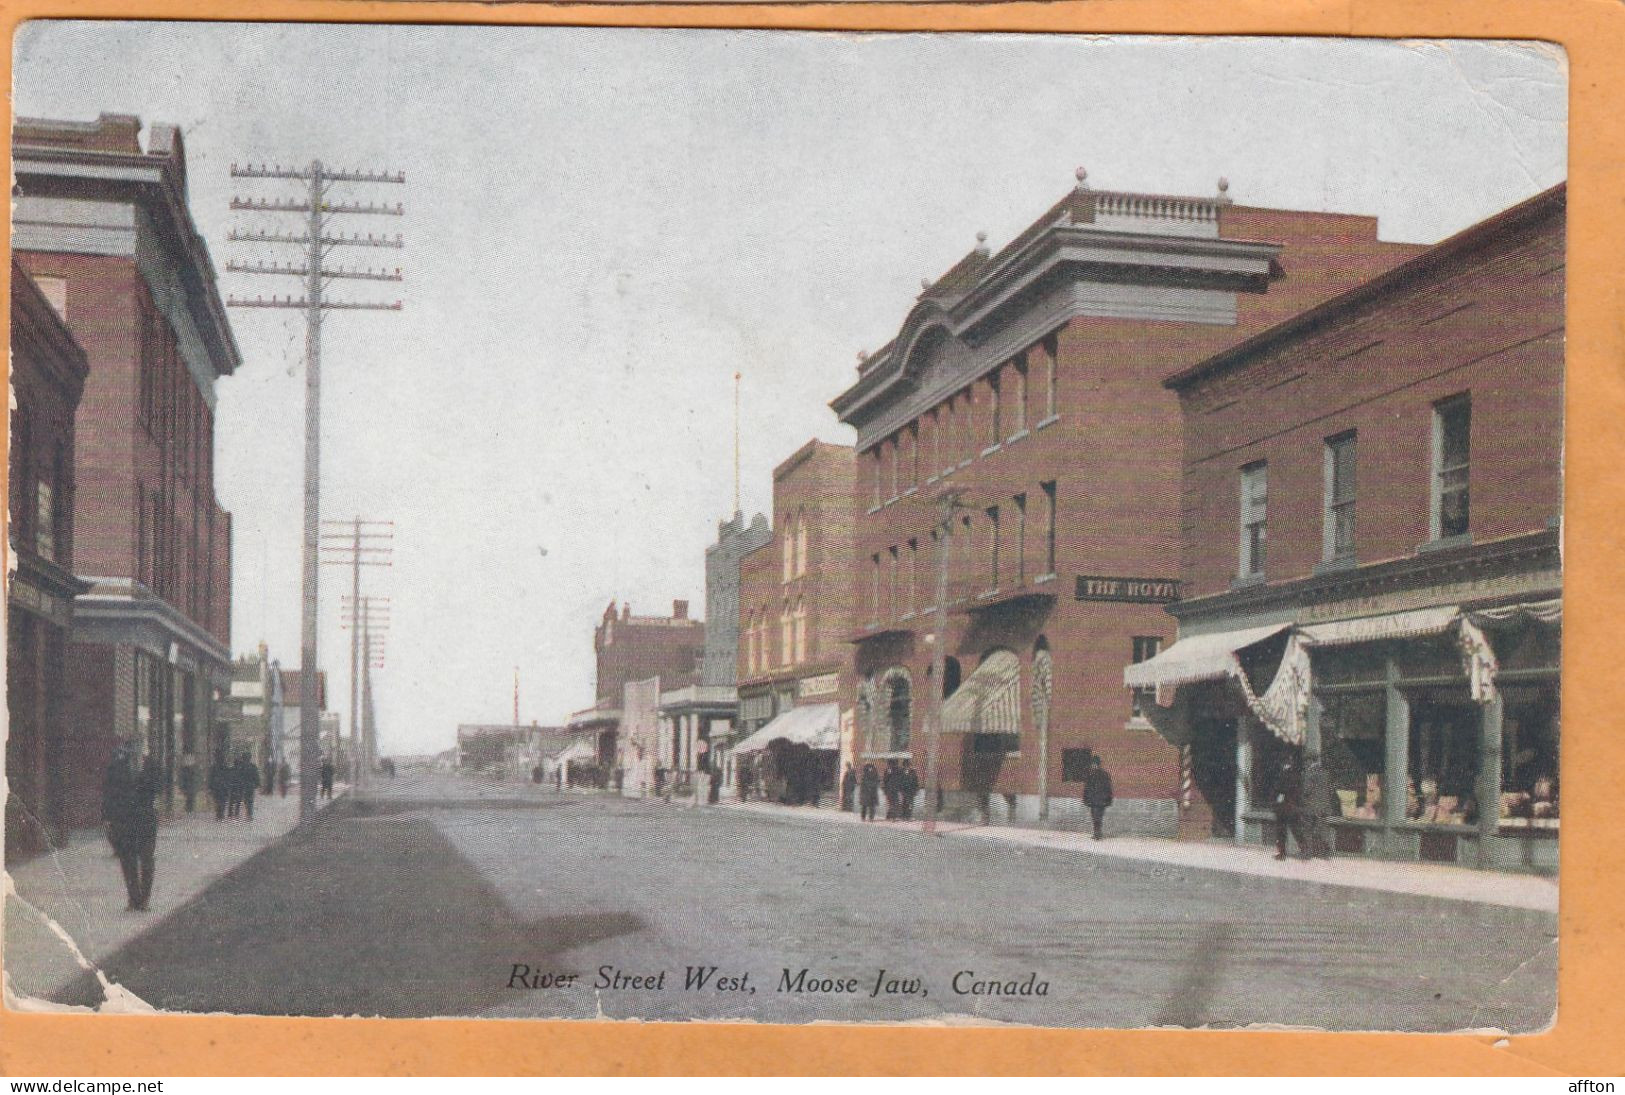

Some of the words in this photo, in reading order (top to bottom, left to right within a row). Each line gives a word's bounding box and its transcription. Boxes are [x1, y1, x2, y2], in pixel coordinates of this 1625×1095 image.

[1087, 580, 1117, 596] THE
[507, 964, 580, 990] River
[594, 964, 665, 992] Street
[685, 966, 756, 994] West,
[776, 967, 858, 993] Moose
[870, 967, 928, 998] Jaw,
[952, 970, 1049, 995] Canada
